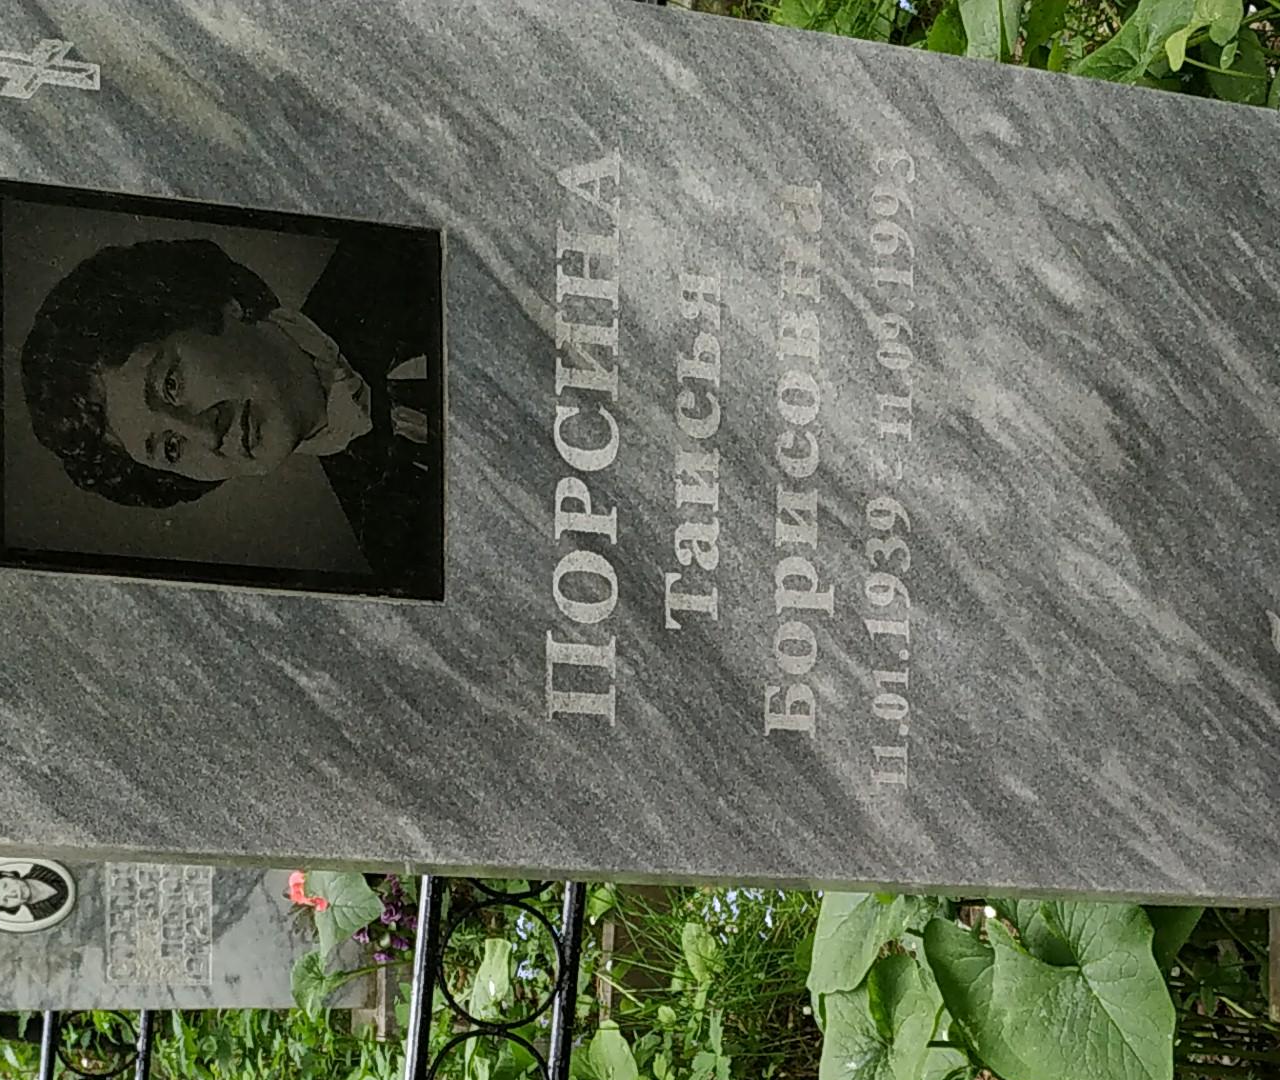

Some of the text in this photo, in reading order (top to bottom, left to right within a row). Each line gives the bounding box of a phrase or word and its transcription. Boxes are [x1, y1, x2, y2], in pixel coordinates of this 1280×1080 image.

[545, 147, 622, 728] ПОРСИНА
[664, 272, 722, 631] Таисья
[763, 179, 836, 738] Борисовна
[863, 495, 913, 789] 11.01.1939
